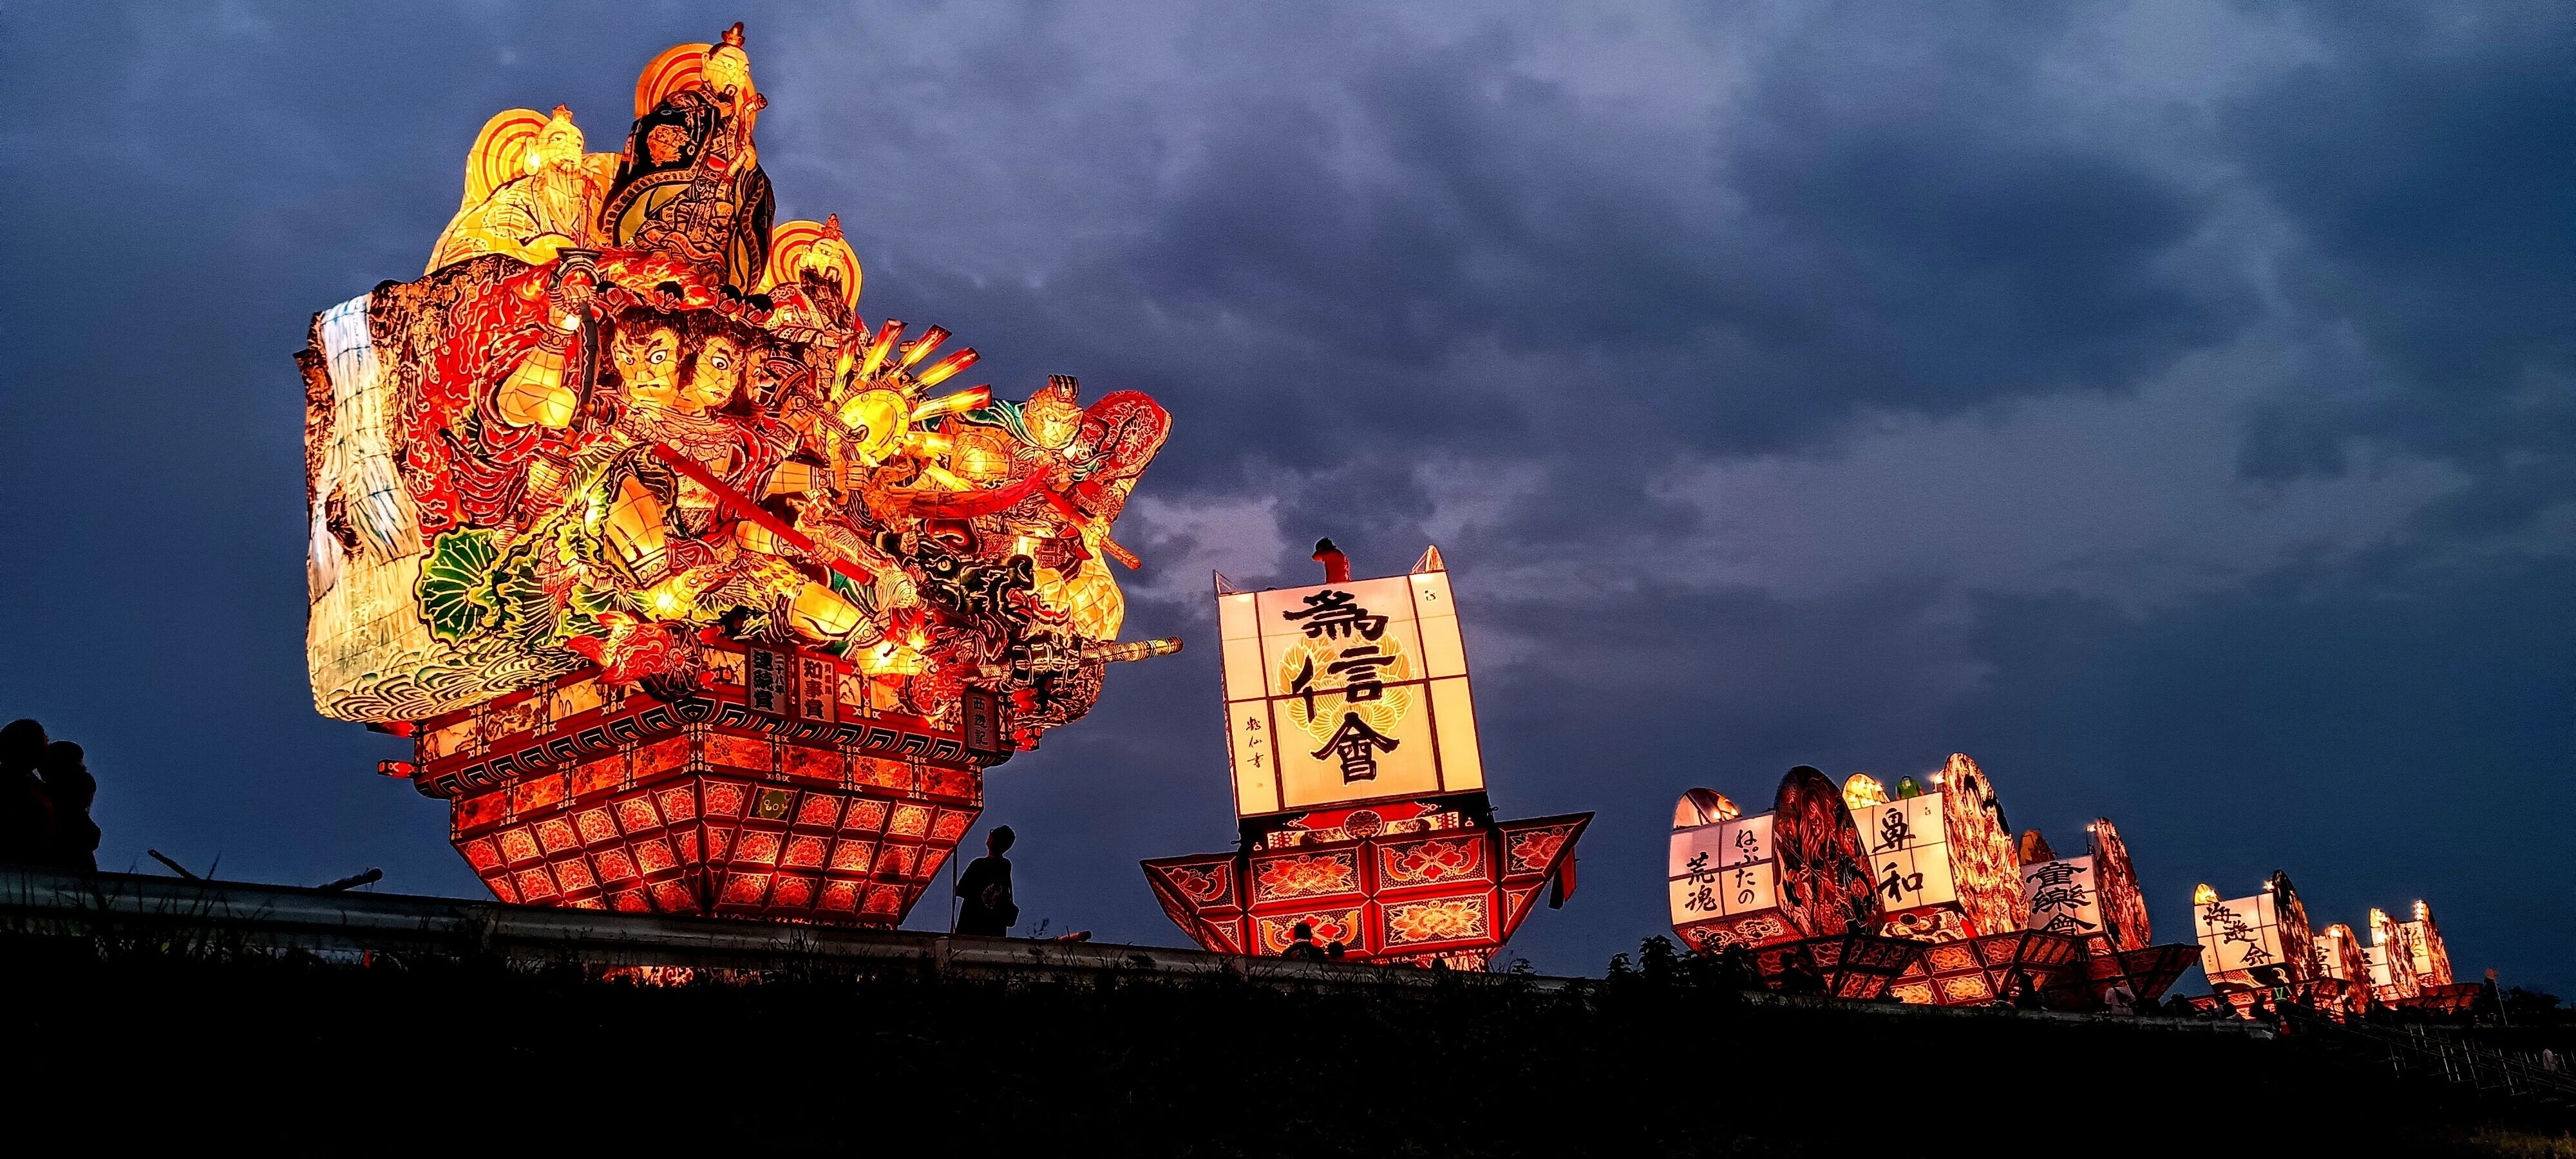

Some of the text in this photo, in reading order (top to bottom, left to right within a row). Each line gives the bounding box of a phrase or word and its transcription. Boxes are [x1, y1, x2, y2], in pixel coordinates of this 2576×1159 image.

[803, 658, 825, 719] 知事賞
[972, 696, 989, 746] 西遊記
[1685, 851, 1718, 912] 荒魂
[1734, 829, 1759, 904] ねぷたの
[1871, 807, 1924, 903] 鼻和
